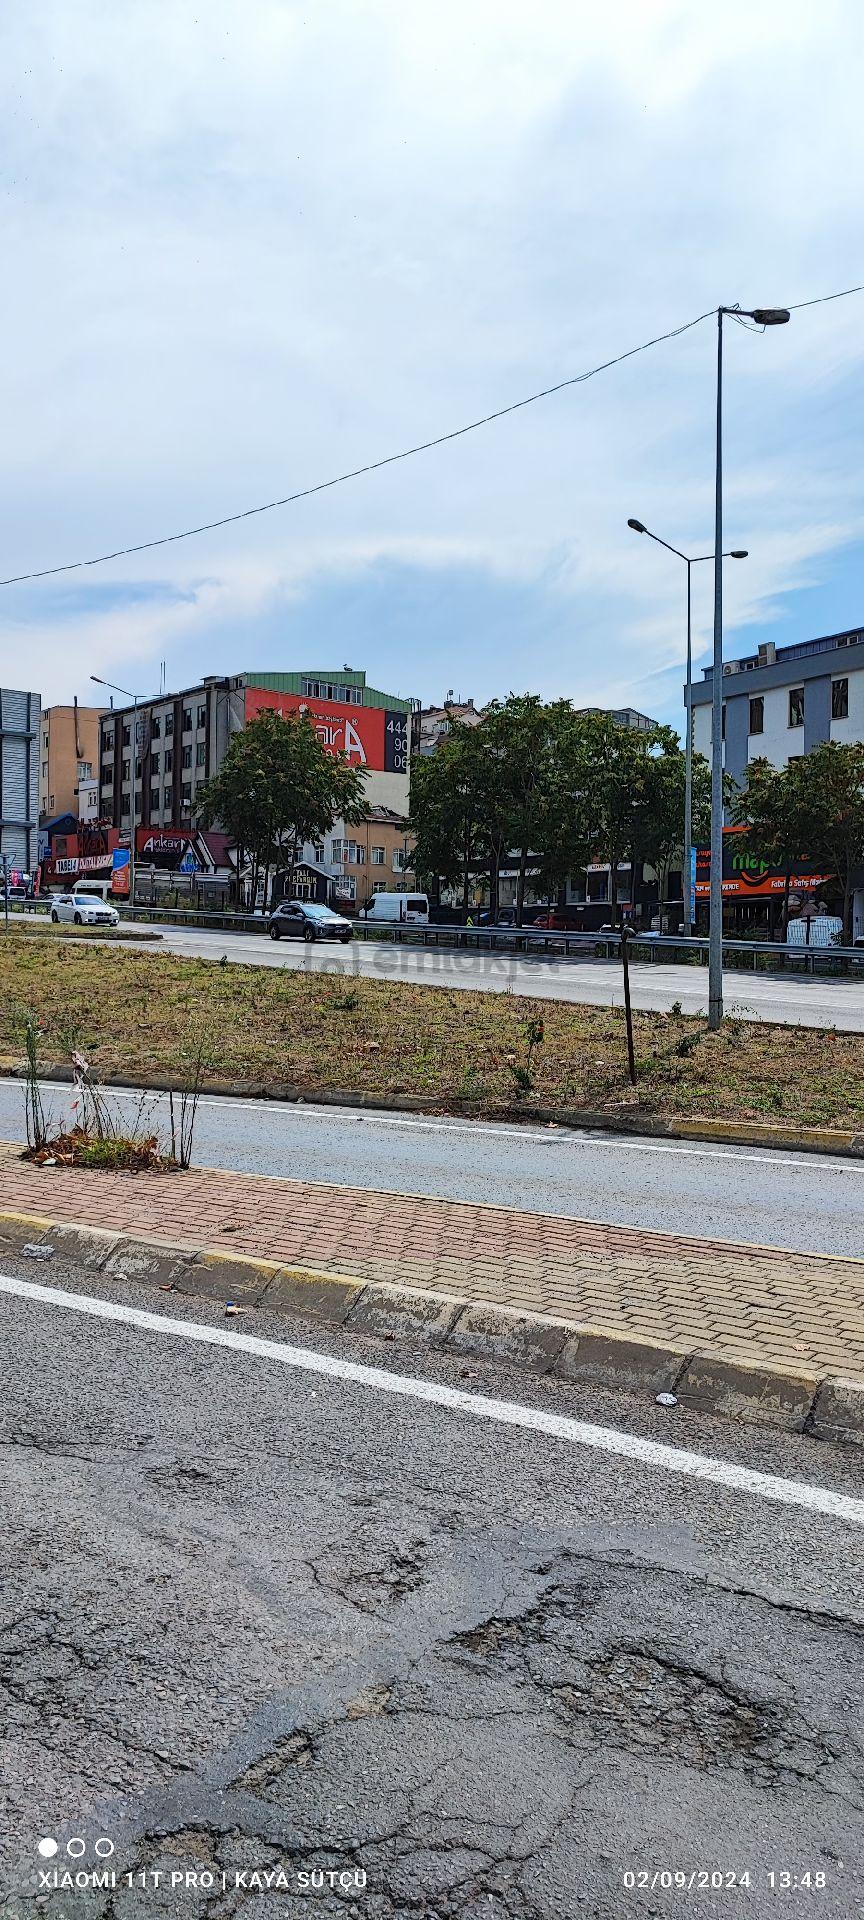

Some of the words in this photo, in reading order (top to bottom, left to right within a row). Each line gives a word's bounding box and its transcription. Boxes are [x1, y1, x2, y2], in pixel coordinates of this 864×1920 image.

[386, 719, 408, 734] 444
[394, 737, 408, 752] 90
[394, 754, 408, 769] 06
[771, 880, 793, 888] Fabria
